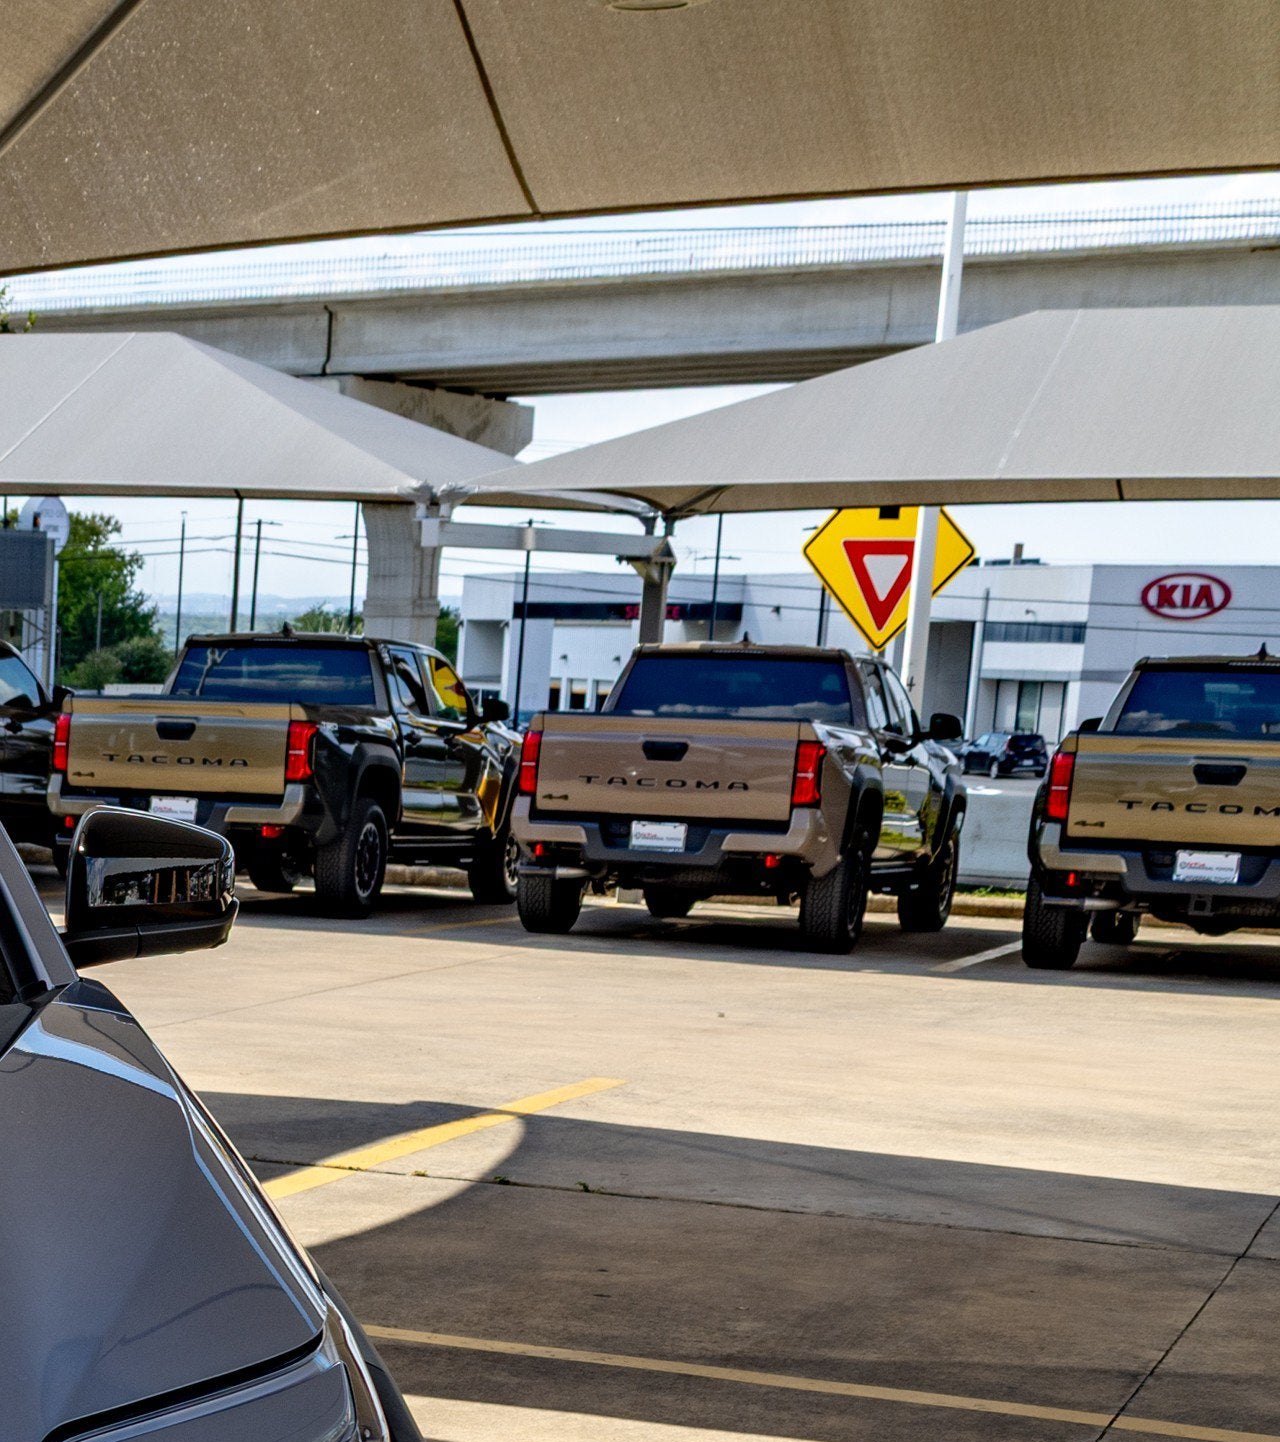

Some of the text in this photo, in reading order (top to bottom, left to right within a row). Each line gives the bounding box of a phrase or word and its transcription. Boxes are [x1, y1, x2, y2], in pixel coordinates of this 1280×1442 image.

[1157, 583, 1215, 609] KIA
[625, 605, 680, 619] SECE
[102, 753, 249, 767] TACOMA
[579, 775, 750, 791] TACOMA
